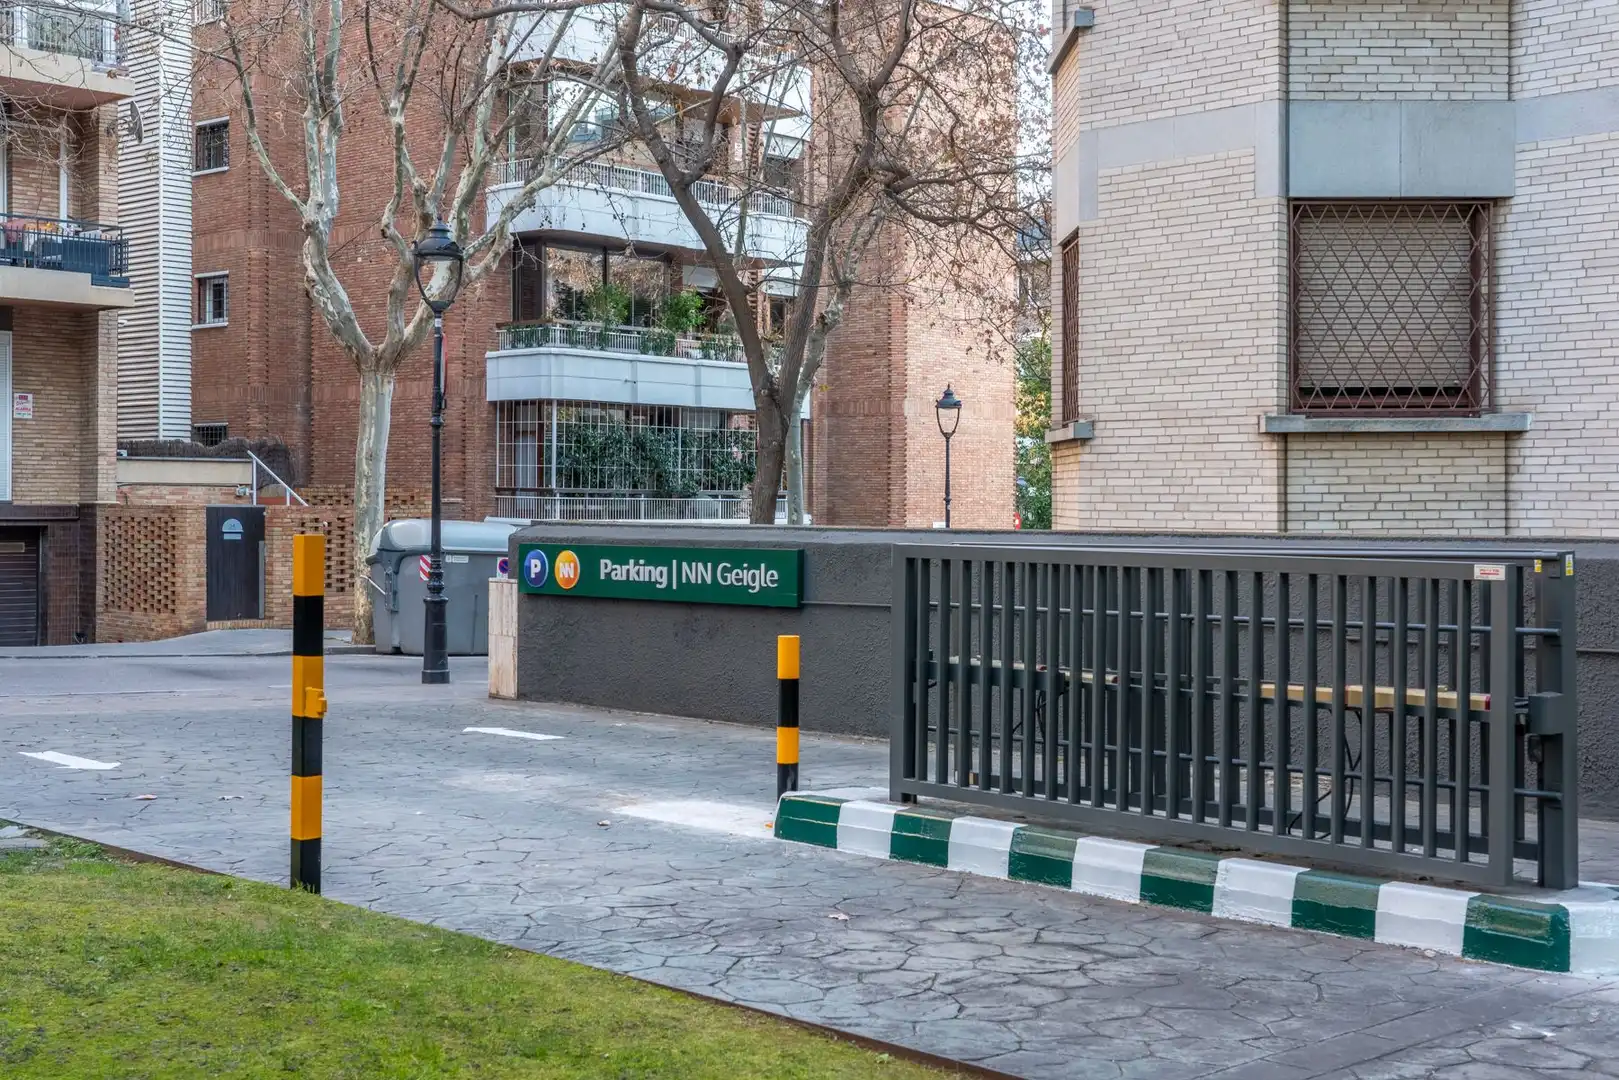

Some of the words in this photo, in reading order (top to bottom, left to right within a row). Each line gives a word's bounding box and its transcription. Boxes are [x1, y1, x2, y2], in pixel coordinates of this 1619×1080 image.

[530, 559, 542, 578] P
[600, 558, 668, 589] Parking
[681, 561, 712, 585] NN
[716, 562, 779, 593] Geigle
